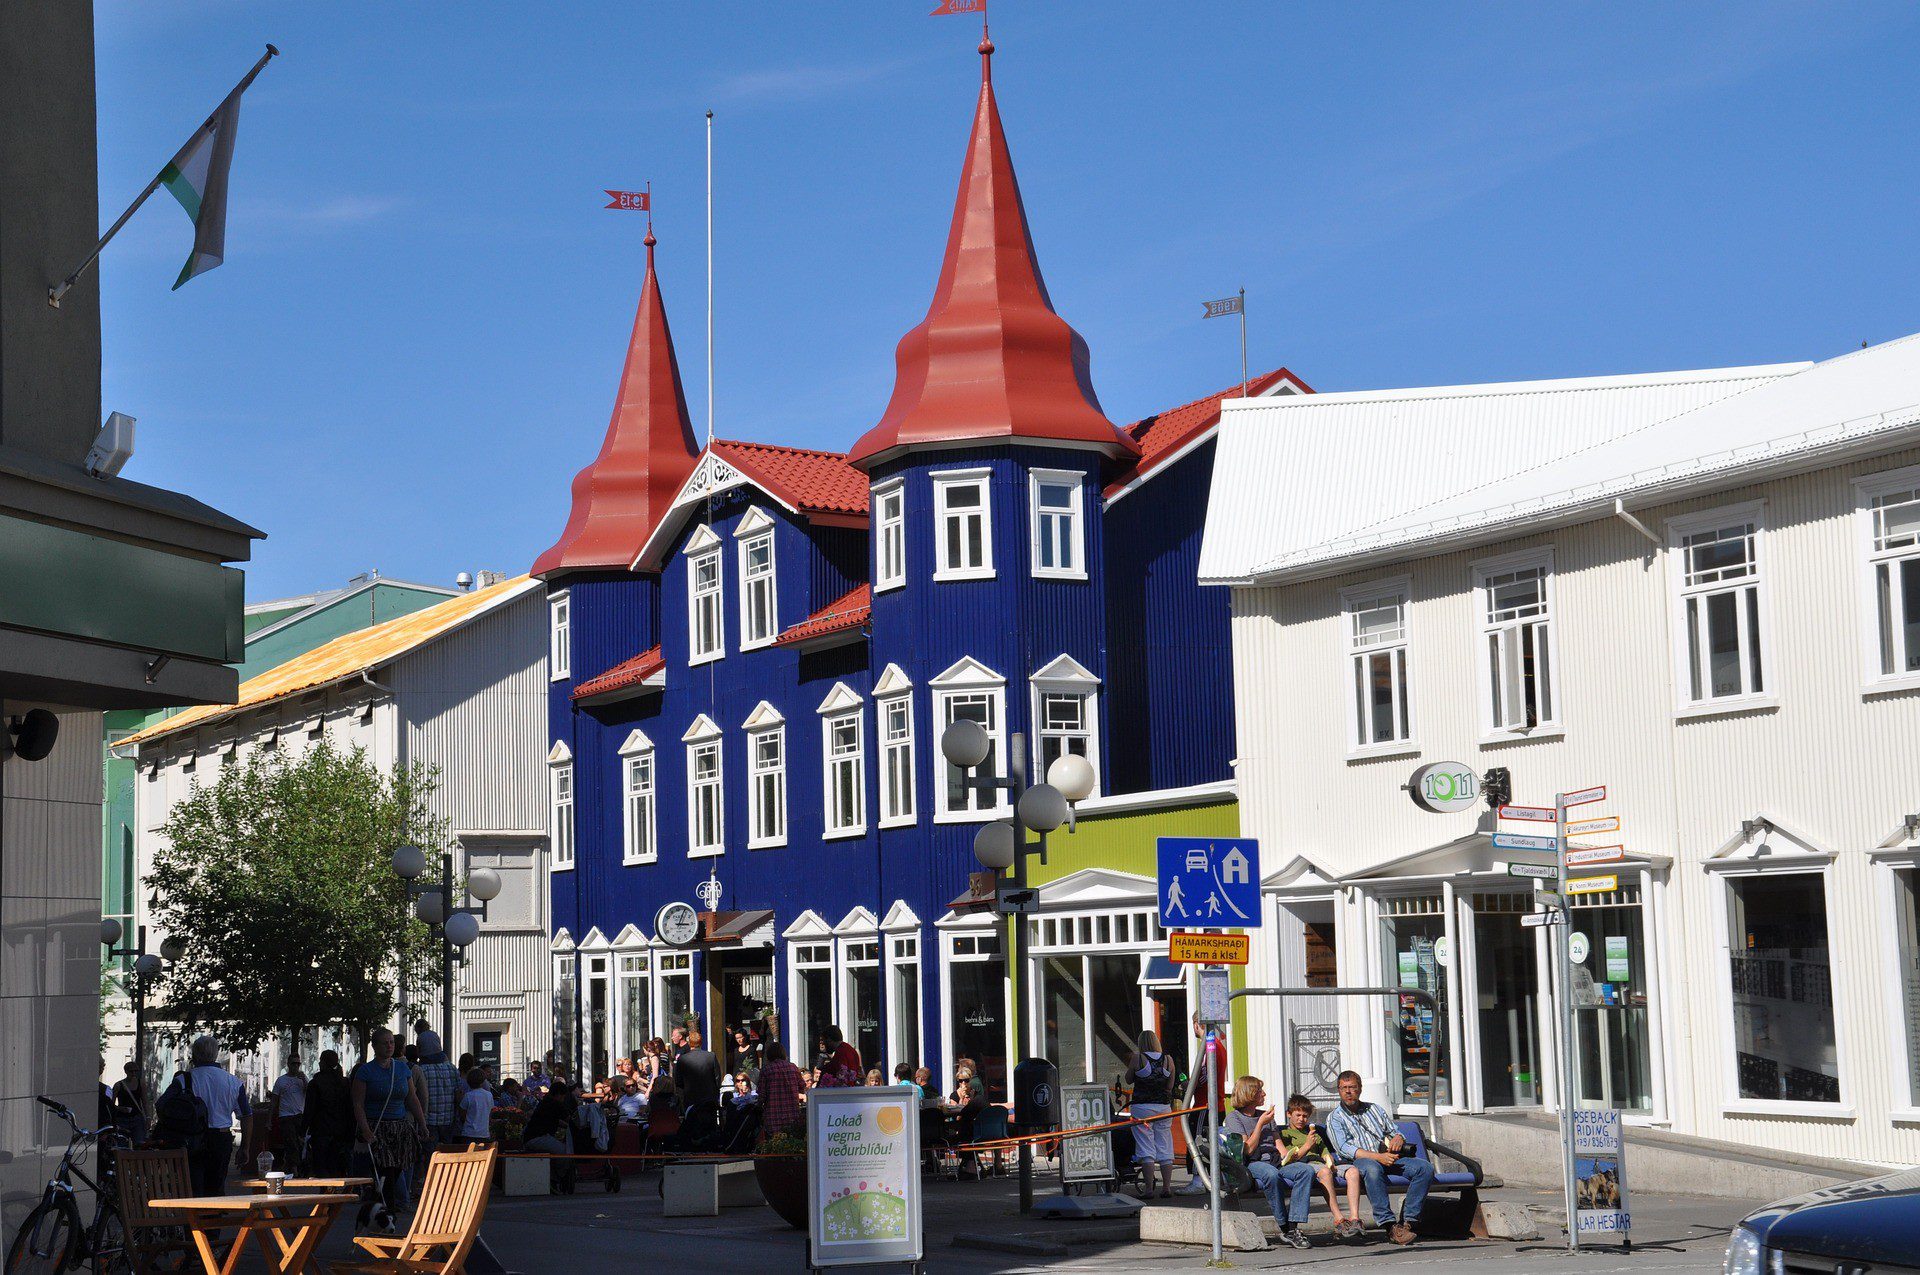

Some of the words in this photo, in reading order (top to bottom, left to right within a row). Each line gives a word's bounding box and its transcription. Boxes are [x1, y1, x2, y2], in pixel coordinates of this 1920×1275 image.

[1510, 838, 1536, 847] Sundlaug
[1175, 937, 1245, 948] HÁMARKSHRAÐI
[1181, 950, 1191, 958] 15
[1194, 950, 1209, 958] km
[1211, 950, 1217, 959] á
[1220, 951, 1240, 960] klst.
[1067, 1099, 1103, 1121] 600
[827, 1114, 862, 1127] Lokað
[1563, 1111, 1617, 1124] HRSEBACK
[828, 1131, 861, 1144] vegna
[1577, 1125, 1609, 1137] RIDING
[828, 1142, 893, 1157] veðurblíðu!
[1069, 1147, 1107, 1163] VERÐI
[1598, 1214, 1631, 1229] HESTAR
